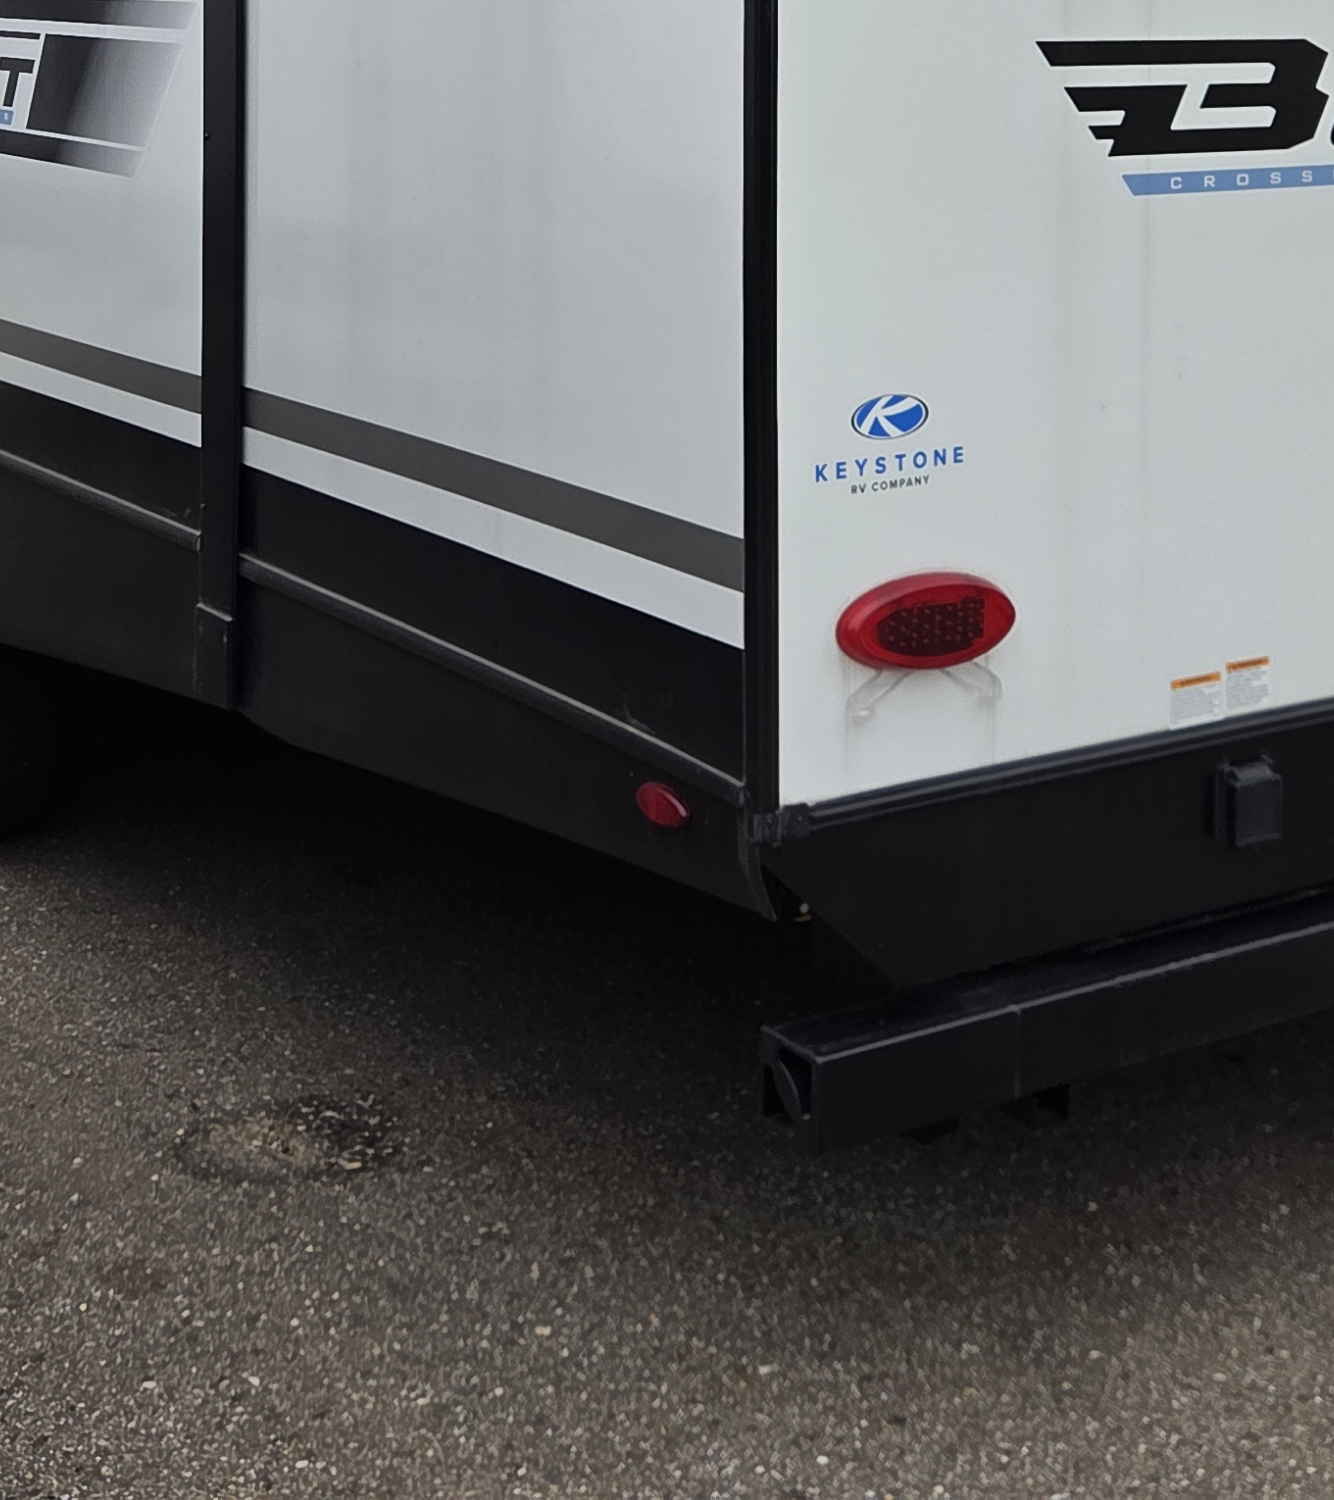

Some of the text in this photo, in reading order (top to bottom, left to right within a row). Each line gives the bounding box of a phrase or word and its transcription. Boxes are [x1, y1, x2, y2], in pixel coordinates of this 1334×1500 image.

[815, 445, 964, 483] KEYSTONE
[851, 474, 930, 495] RV COMPANY
